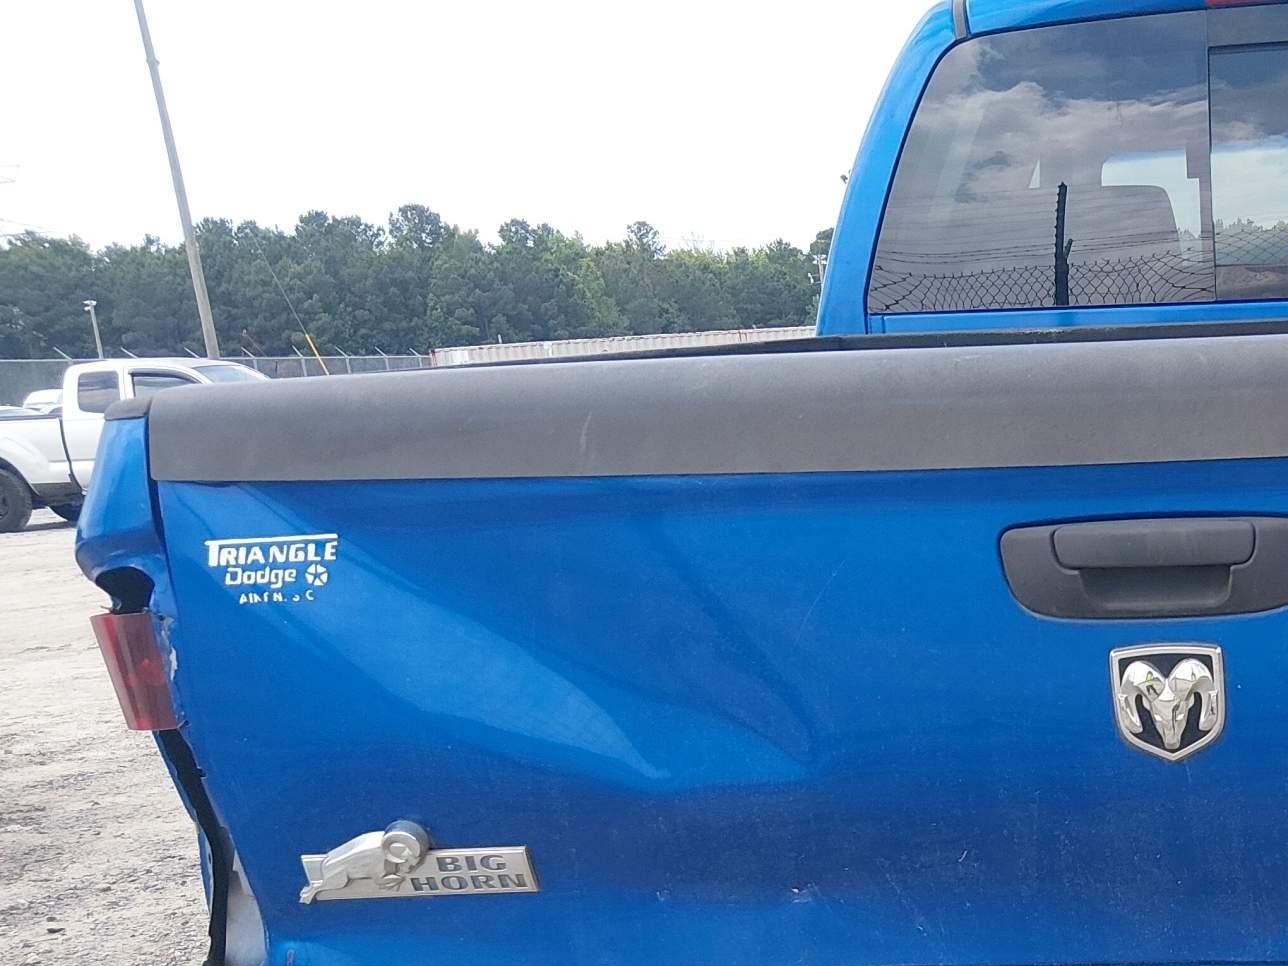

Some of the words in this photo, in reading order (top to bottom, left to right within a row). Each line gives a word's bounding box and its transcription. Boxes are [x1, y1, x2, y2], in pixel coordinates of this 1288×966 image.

[204, 533, 339, 567] TRIANGLE
[225, 566, 297, 588] Dodge
[435, 854, 507, 872] BIG
[410, 873, 529, 892] HORN
